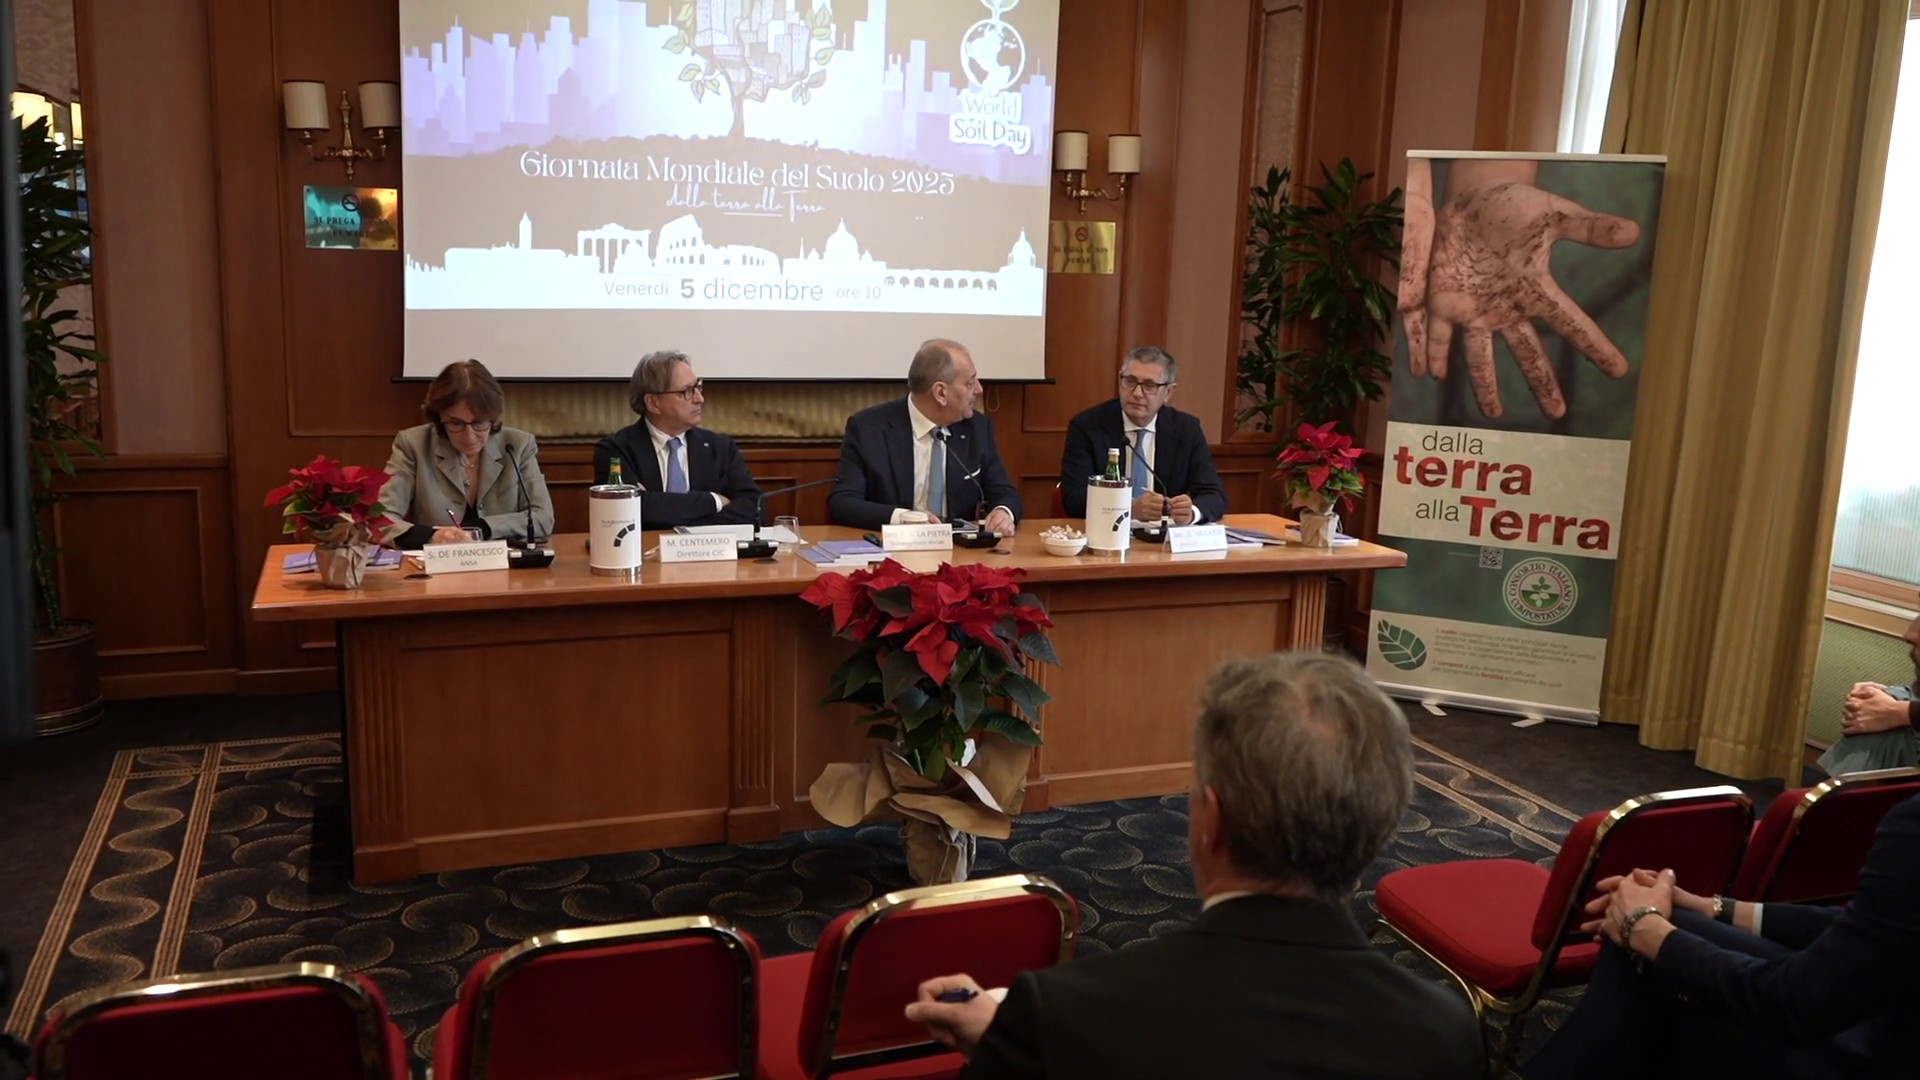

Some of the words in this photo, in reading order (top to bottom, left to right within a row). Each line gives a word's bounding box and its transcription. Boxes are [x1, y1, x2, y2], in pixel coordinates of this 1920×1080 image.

[965, 94, 1018, 118] World
[954, 118, 987, 140] Soil
[993, 121, 1027, 150] Day
[520, 150, 638, 180] Giornata
[647, 156, 764, 185] Mondiale
[771, 163, 809, 188] del
[816, 165, 884, 191] Suolo
[892, 169, 955, 194] 2025
[666, 184, 708, 208] dalla
[711, 187, 749, 208] terra
[755, 186, 784, 210] alla
[782, 190, 825, 223] Terra
[327, 216, 356, 225] PREGA
[603, 280, 669, 296] Venerdì
[680, 278, 695, 299] 5
[703, 278, 823, 301] dicembre
[836, 287, 860, 299] ore
[866, 286, 881, 299] 10
[1422, 431, 1484, 455] dalla
[1393, 446, 1532, 496] terra
[1415, 499, 1460, 522] alla
[1460, 496, 1611, 551] Terra
[428, 550, 436, 560] S.
[438, 550, 450, 559] DE
[452, 547, 504, 557] FRANCESCO
[667, 539, 678, 547] M.
[680, 537, 730, 547] CENTEMERO
[677, 550, 711, 558] Direttore
[1509, 563, 1545, 597] CONSORZIO
[1549, 565, 1572, 601] ITALIANO
[1511, 598, 1568, 620] COMPOSTATORI
